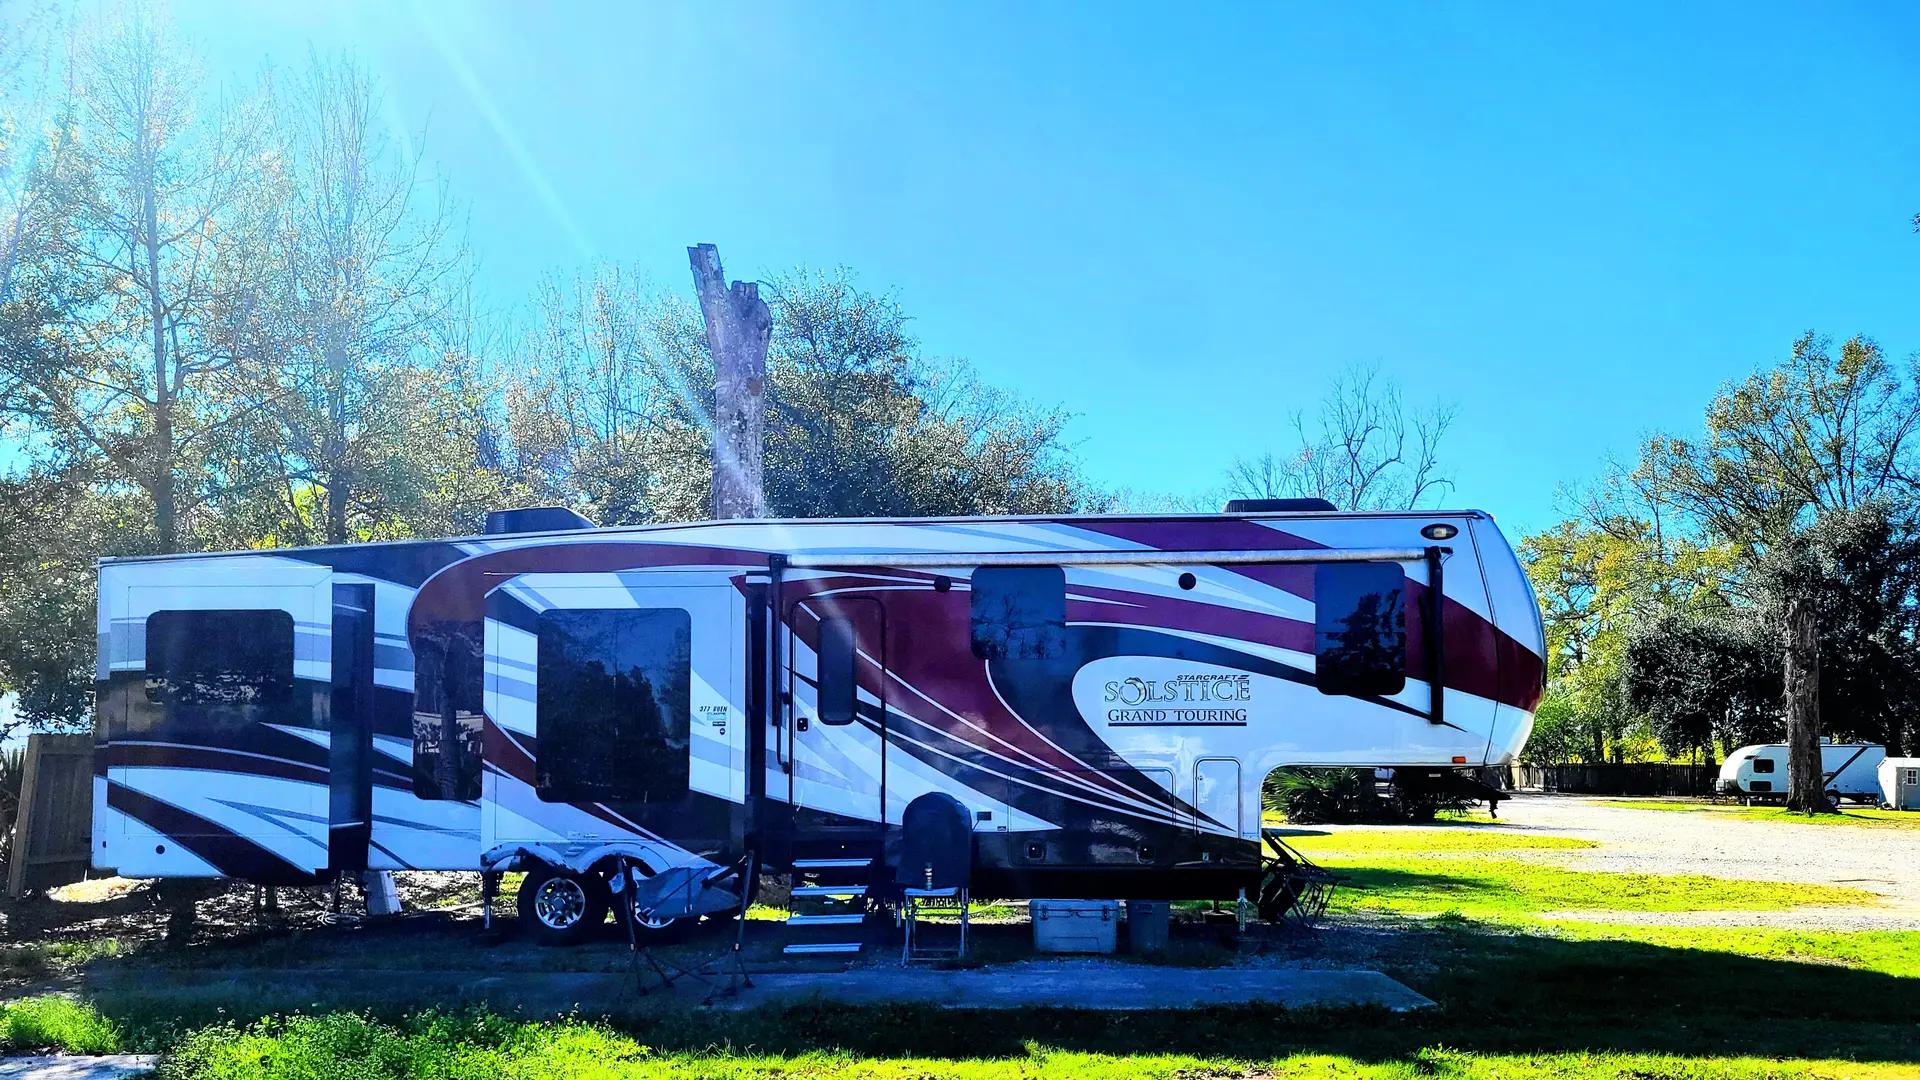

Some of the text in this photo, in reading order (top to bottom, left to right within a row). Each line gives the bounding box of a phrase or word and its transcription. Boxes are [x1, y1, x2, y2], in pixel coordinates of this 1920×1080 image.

[1105, 677, 1251, 706] SOLSTICE
[1108, 709, 1247, 721] GRAND TOURING
